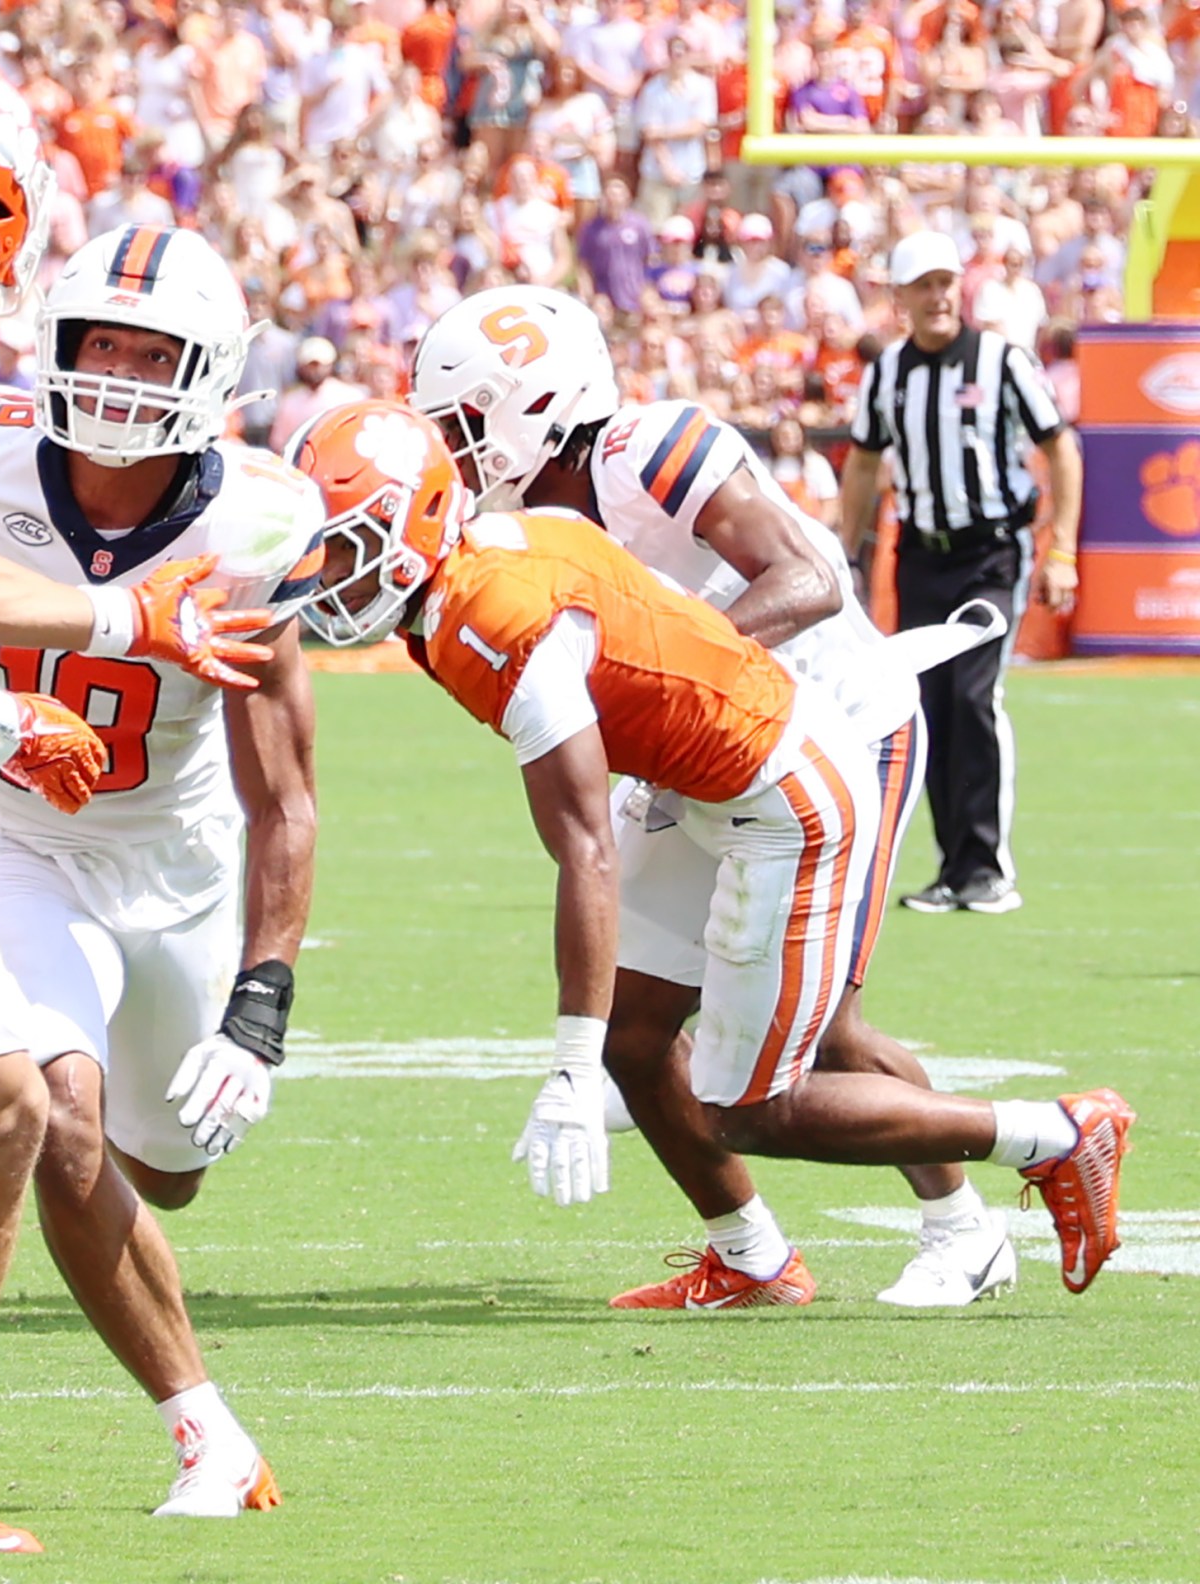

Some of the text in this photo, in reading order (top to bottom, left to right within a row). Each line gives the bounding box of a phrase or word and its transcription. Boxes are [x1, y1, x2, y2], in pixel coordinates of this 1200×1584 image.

[479, 305, 549, 368] S
[9, 519, 47, 541] ACC
[90, 549, 114, 577] S
[457, 624, 511, 671] 1
